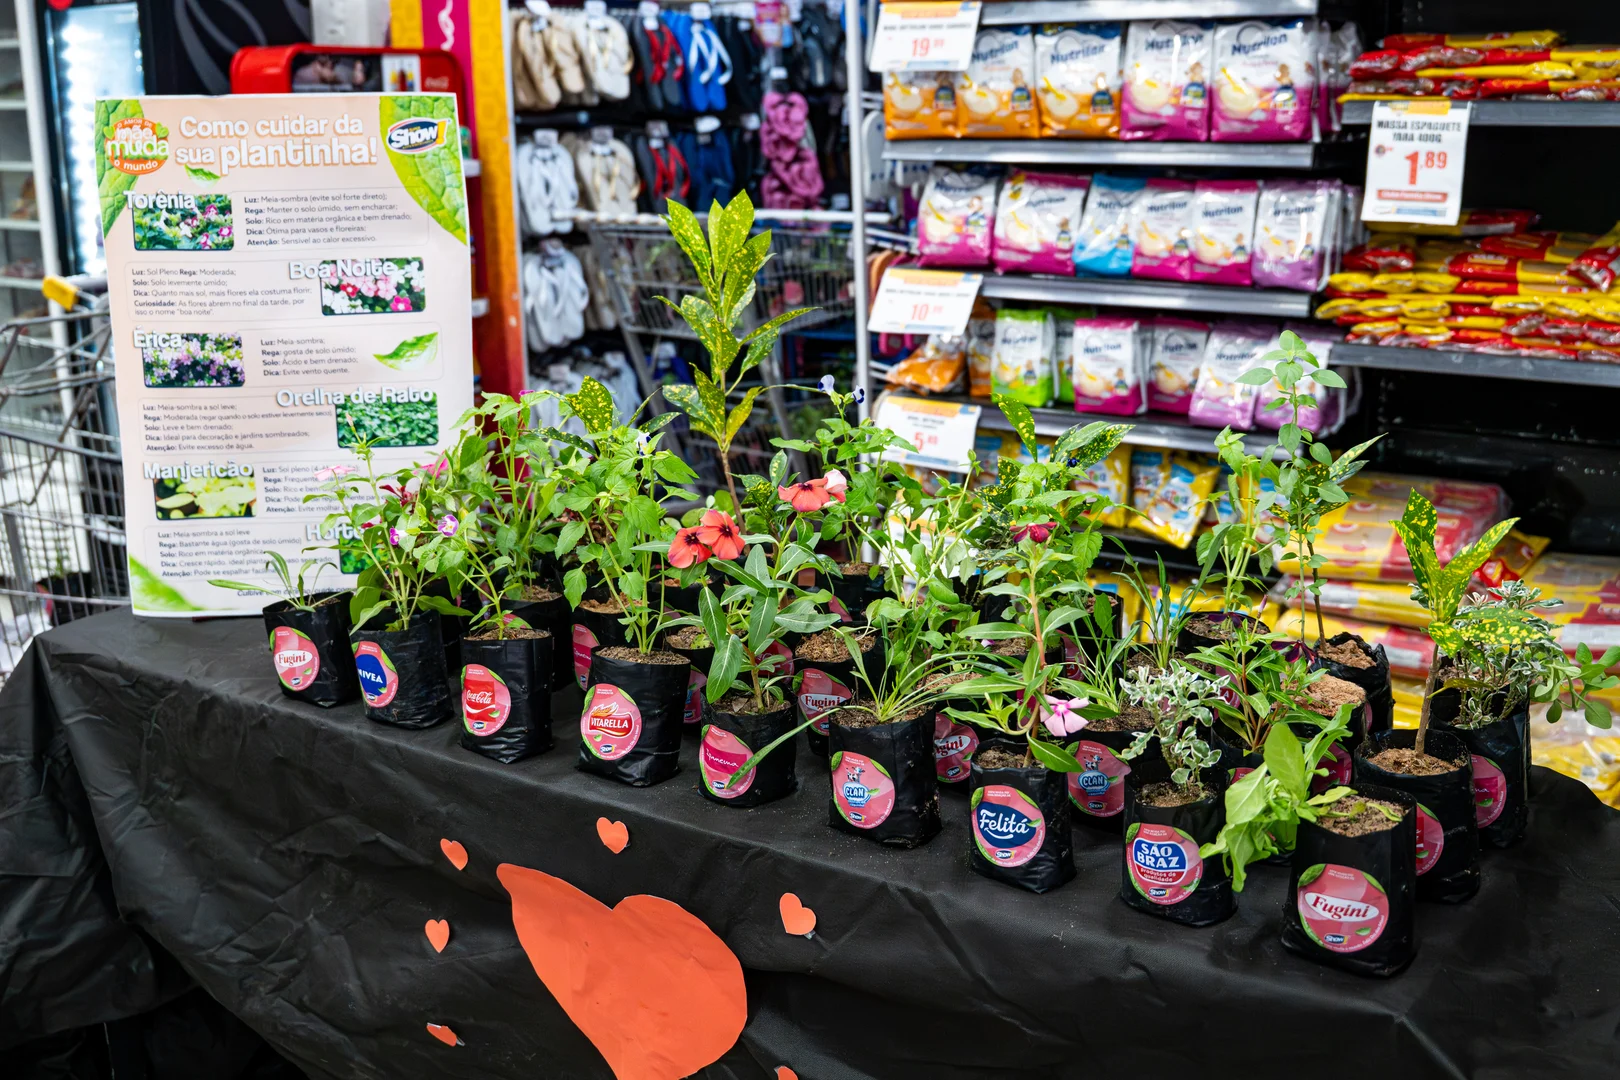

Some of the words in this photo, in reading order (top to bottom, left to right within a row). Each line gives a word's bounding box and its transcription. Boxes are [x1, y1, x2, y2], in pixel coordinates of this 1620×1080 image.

[1231, 32, 1288, 56] Nutrilon
[180, 116, 250, 138] Como
[255, 114, 328, 138] cuidar
[334, 114, 363, 136] da
[106, 135, 169, 156] muda
[175, 146, 216, 165] sua
[220, 136, 378, 176] plantinha!
[124, 161, 158, 171] mundo
[123, 189, 196, 209] Torênia
[245, 207, 265, 215] Rega:
[1202, 206, 1243, 218] Nutrilon
[291, 228, 306, 236] para
[247, 238, 280, 246] Atenção:
[148, 268, 157, 276] Sol
[159, 268, 178, 276] Pleno
[180, 269, 198, 277] Rega:
[289, 261, 331, 280] Boa
[336, 258, 394, 277] Noite
[209, 299, 230, 307] abrem
[133, 325, 182, 349] Érica
[276, 387, 345, 407] Orelha
[350, 386, 376, 404] de
[381, 386, 433, 404] Rato
[143, 460, 253, 483] Manjericão
[279, 652, 306, 666] Fugini
[358, 668, 383, 683] NIVEA
[805, 696, 840, 708] Fugini
[591, 718, 629, 728] VITARELLA
[1083, 776, 1103, 785] CLAN
[846, 786, 864, 796] CLAN
[980, 809, 1029, 834] Felitá
[1141, 843, 1172, 857] SÃO
[1137, 851, 1180, 868] BRAZ
[1312, 895, 1370, 919] Fugini
